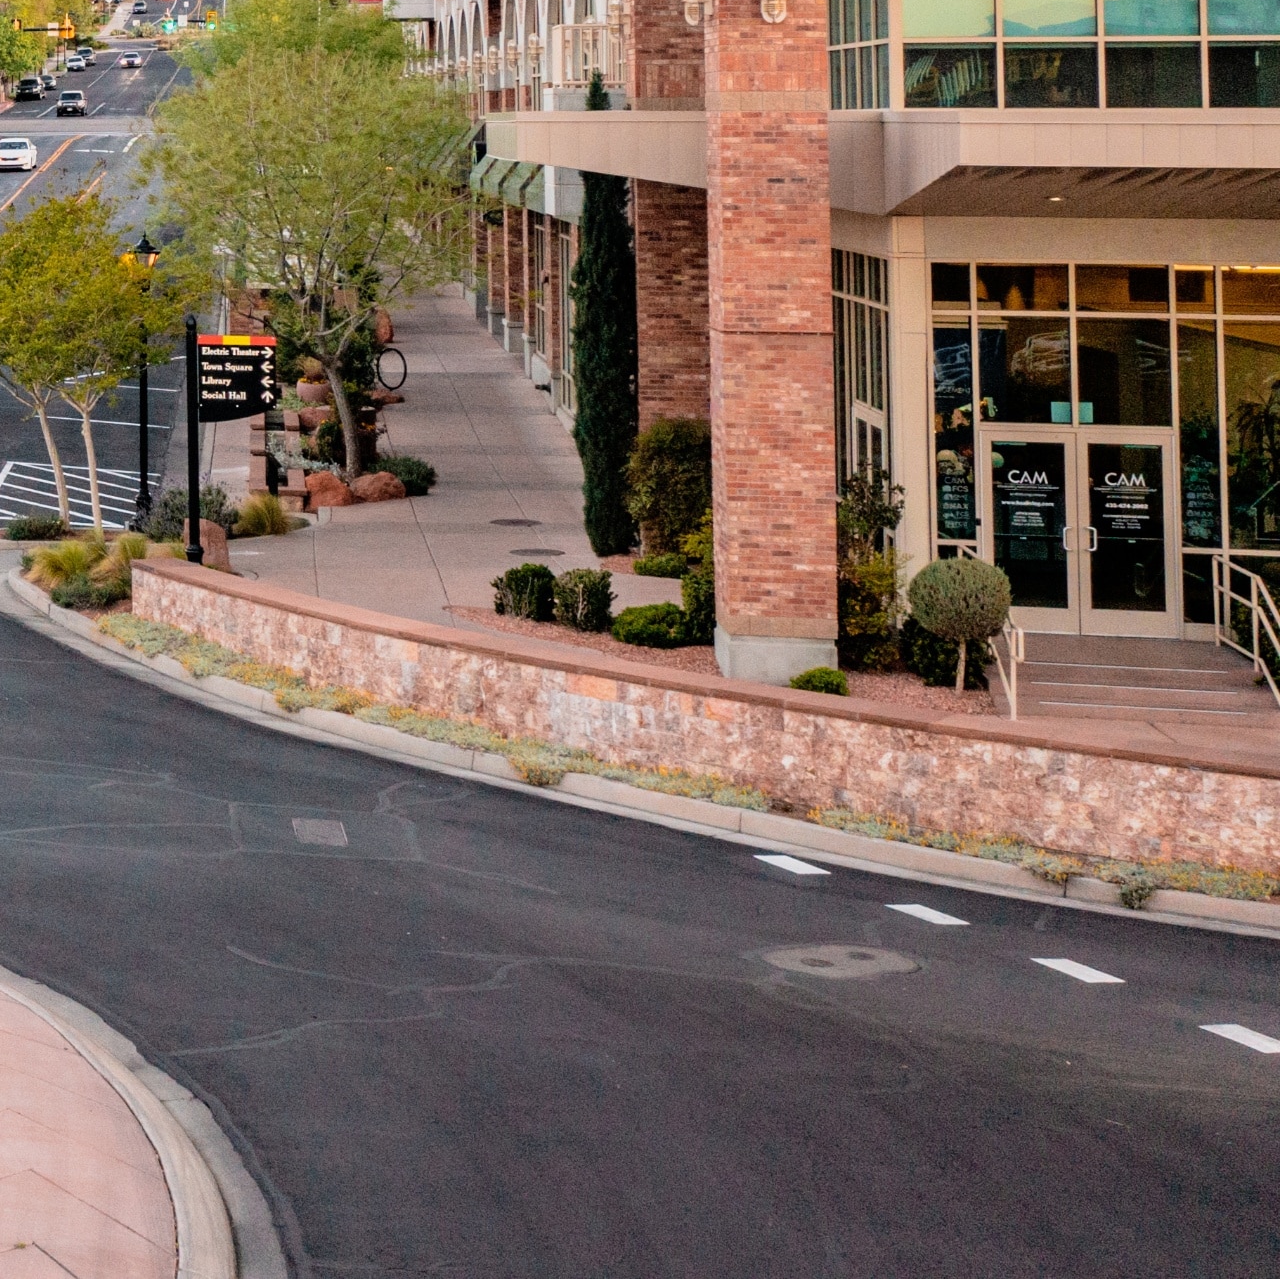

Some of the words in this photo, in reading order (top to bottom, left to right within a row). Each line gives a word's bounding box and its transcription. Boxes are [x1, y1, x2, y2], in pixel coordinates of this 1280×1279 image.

[201, 346, 230, 356] Electric
[231, 347, 260, 356] Theater
[201, 362, 223, 371] Town
[225, 362, 254, 373] Square
[201, 376, 232, 387] Library
[201, 391, 226, 400] Social
[228, 391, 247, 400] Hall
[1007, 469, 1048, 484] CAM
[1104, 472, 1146, 487] CAM
